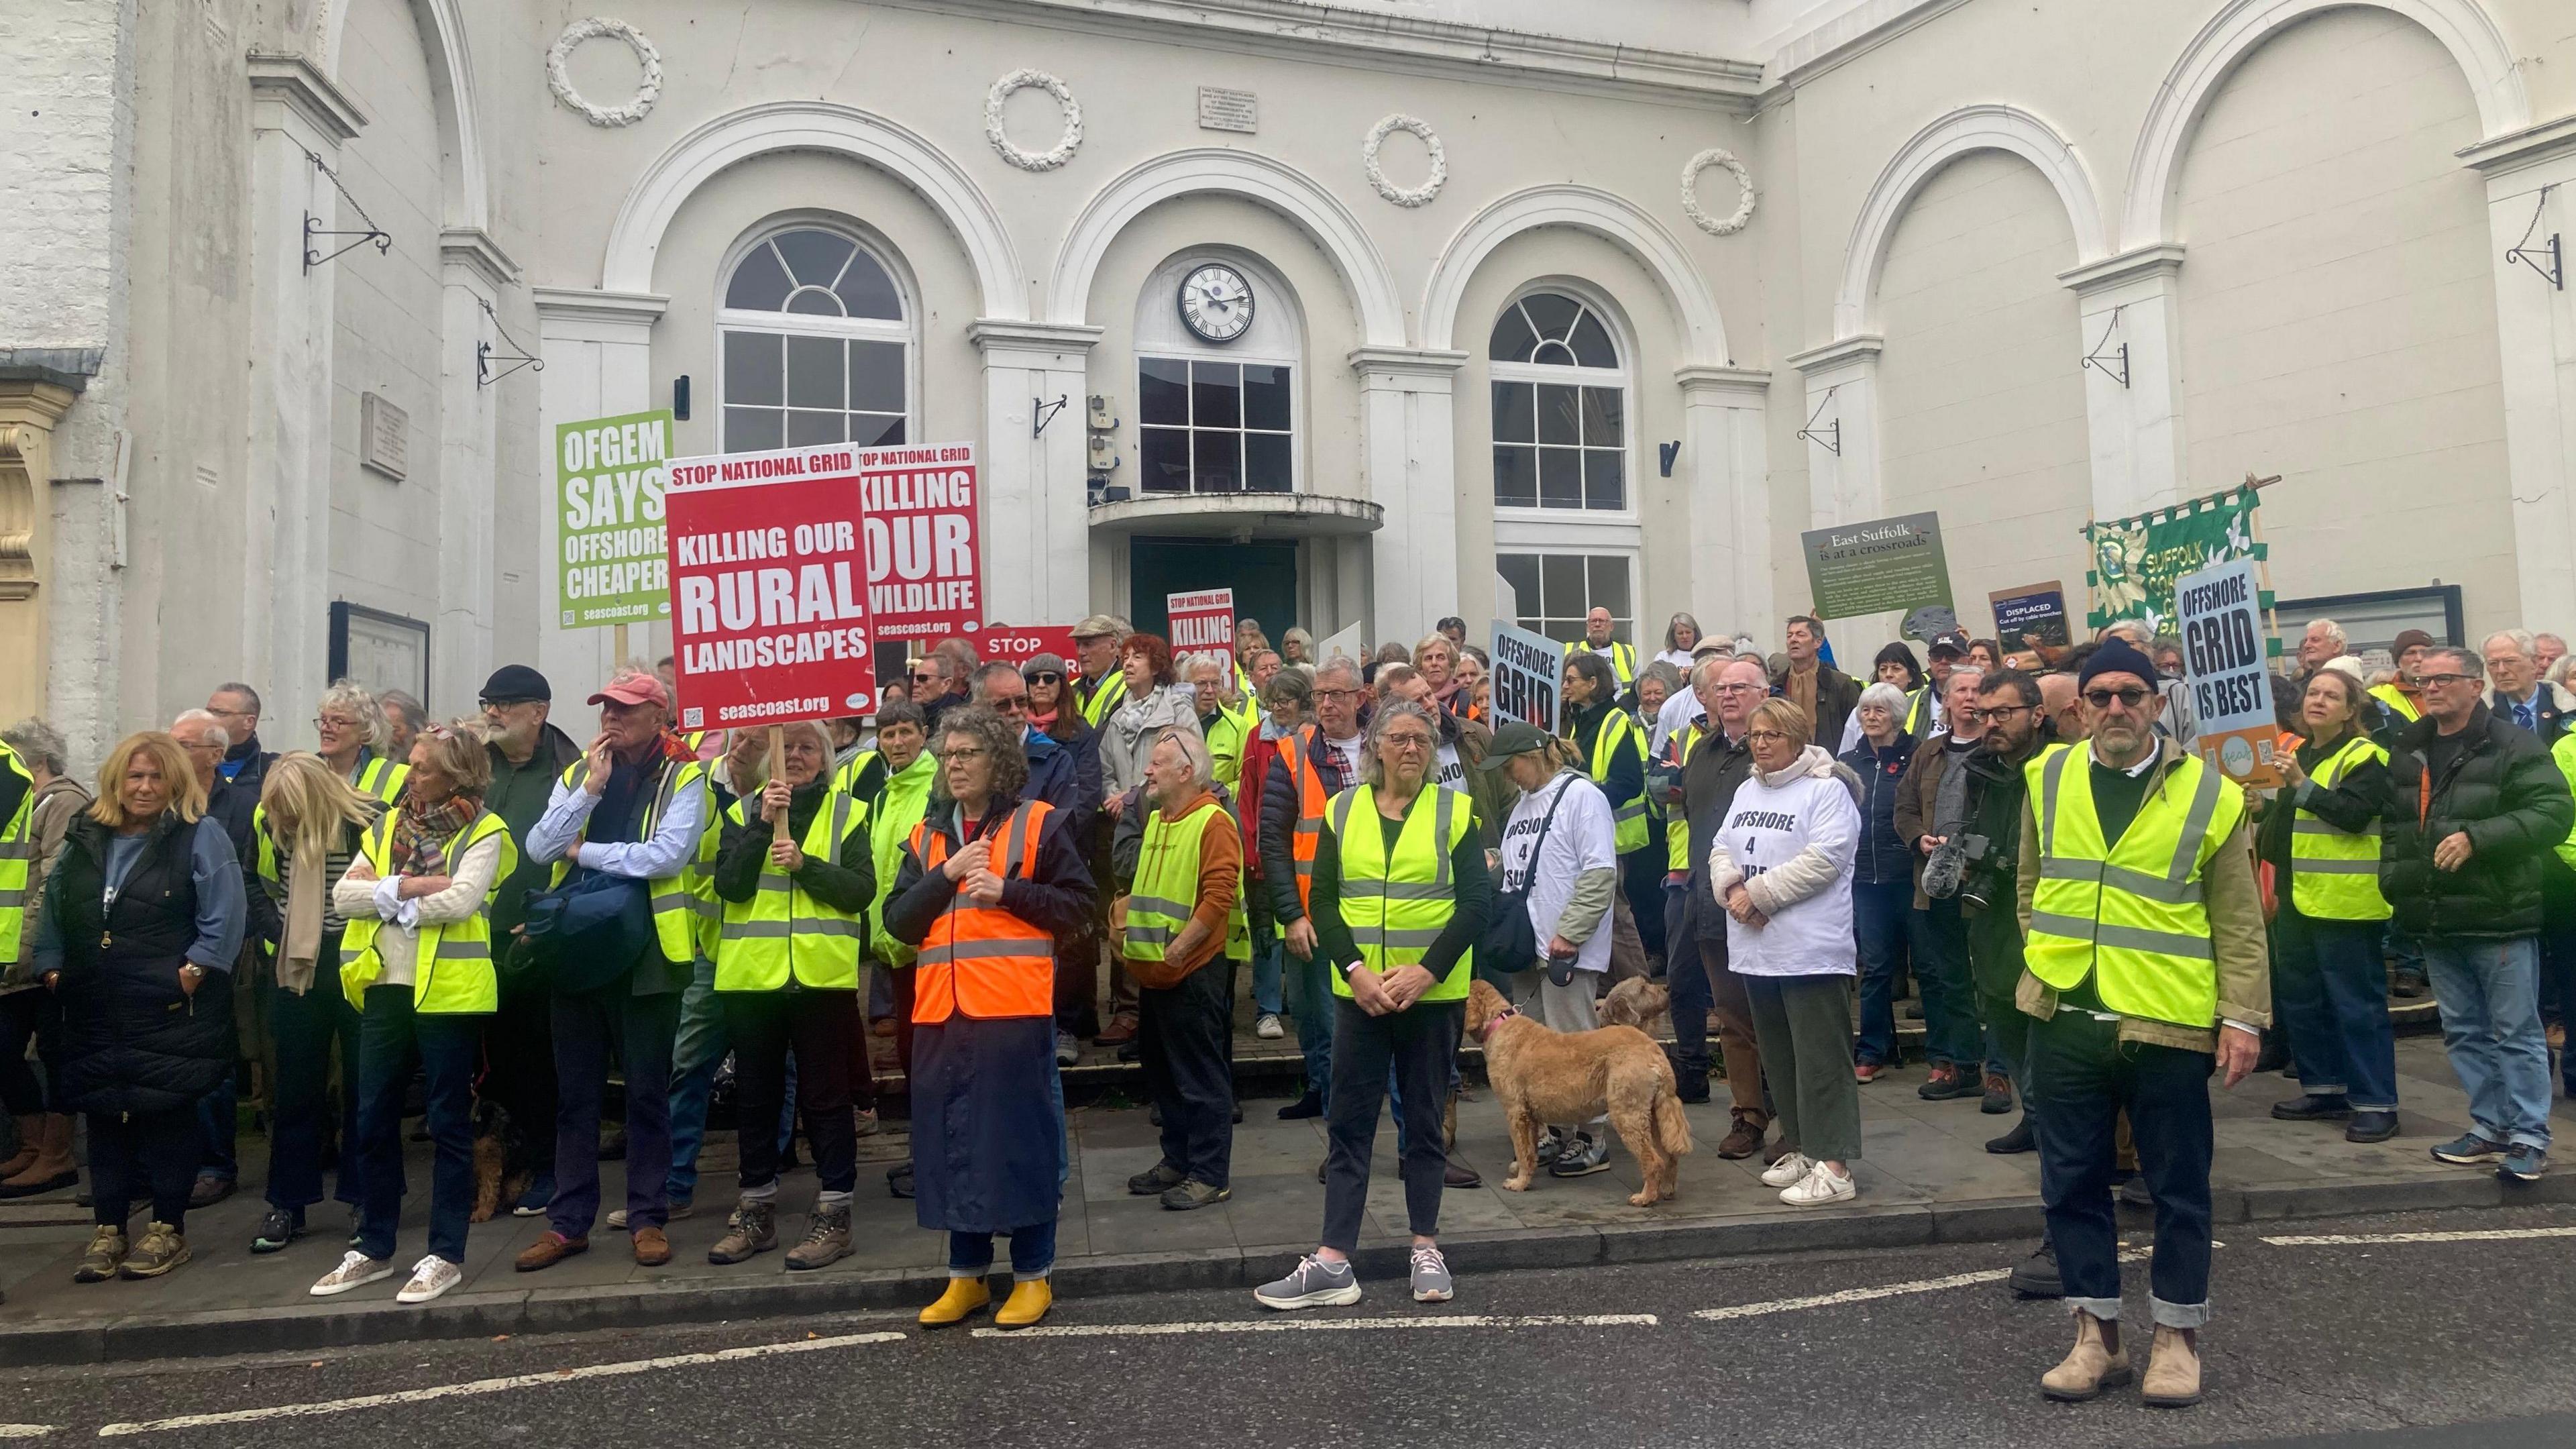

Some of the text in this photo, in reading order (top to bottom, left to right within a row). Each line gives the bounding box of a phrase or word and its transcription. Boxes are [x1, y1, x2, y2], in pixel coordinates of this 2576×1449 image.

[565, 420, 665, 472] OFGEM
[881, 449, 938, 466] NATIONAL
[941, 447, 970, 462] GRID
[672, 453, 852, 486] STOP NATIONAL GRID
[566, 467, 666, 530] SAYS
[861, 470, 971, 512] KILLING
[566, 525, 668, 564] OFFSHORE
[678, 521, 855, 567] KILLING OUR
[864, 514, 973, 582] OUR
[1820, 535, 1927, 561] is at a crossroads
[1831, 524, 1911, 547] East Suffolk
[2146, 540, 2205, 574] SUFFOLK
[567, 559, 669, 599] CHEAPER
[2182, 573, 2247, 618] OFFSHORE
[584, 604, 649, 620] seascoast.org
[679, 561, 863, 635] RURAL
[1171, 593, 1230, 609] STOP NATIONAL GRID
[2006, 604, 2051, 616] DISPLACED
[877, 622, 951, 636] seascoast.org
[988, 638, 1042, 653] STOP
[1172, 614, 1232, 647] KILLING
[2187, 608, 2256, 678] GRID
[684, 627, 867, 675] LANDSCAPES
[1497, 634, 1555, 680] OFFSHORE
[719, 696, 830, 720] seascoast.org
[1495, 662, 1553, 733] GRID
[2196, 672, 2262, 720] IS BEST
[1732, 810, 1796, 832] OFFSHORE
[1519, 843, 1527, 860] 4
[1746, 837, 1756, 854] 4
